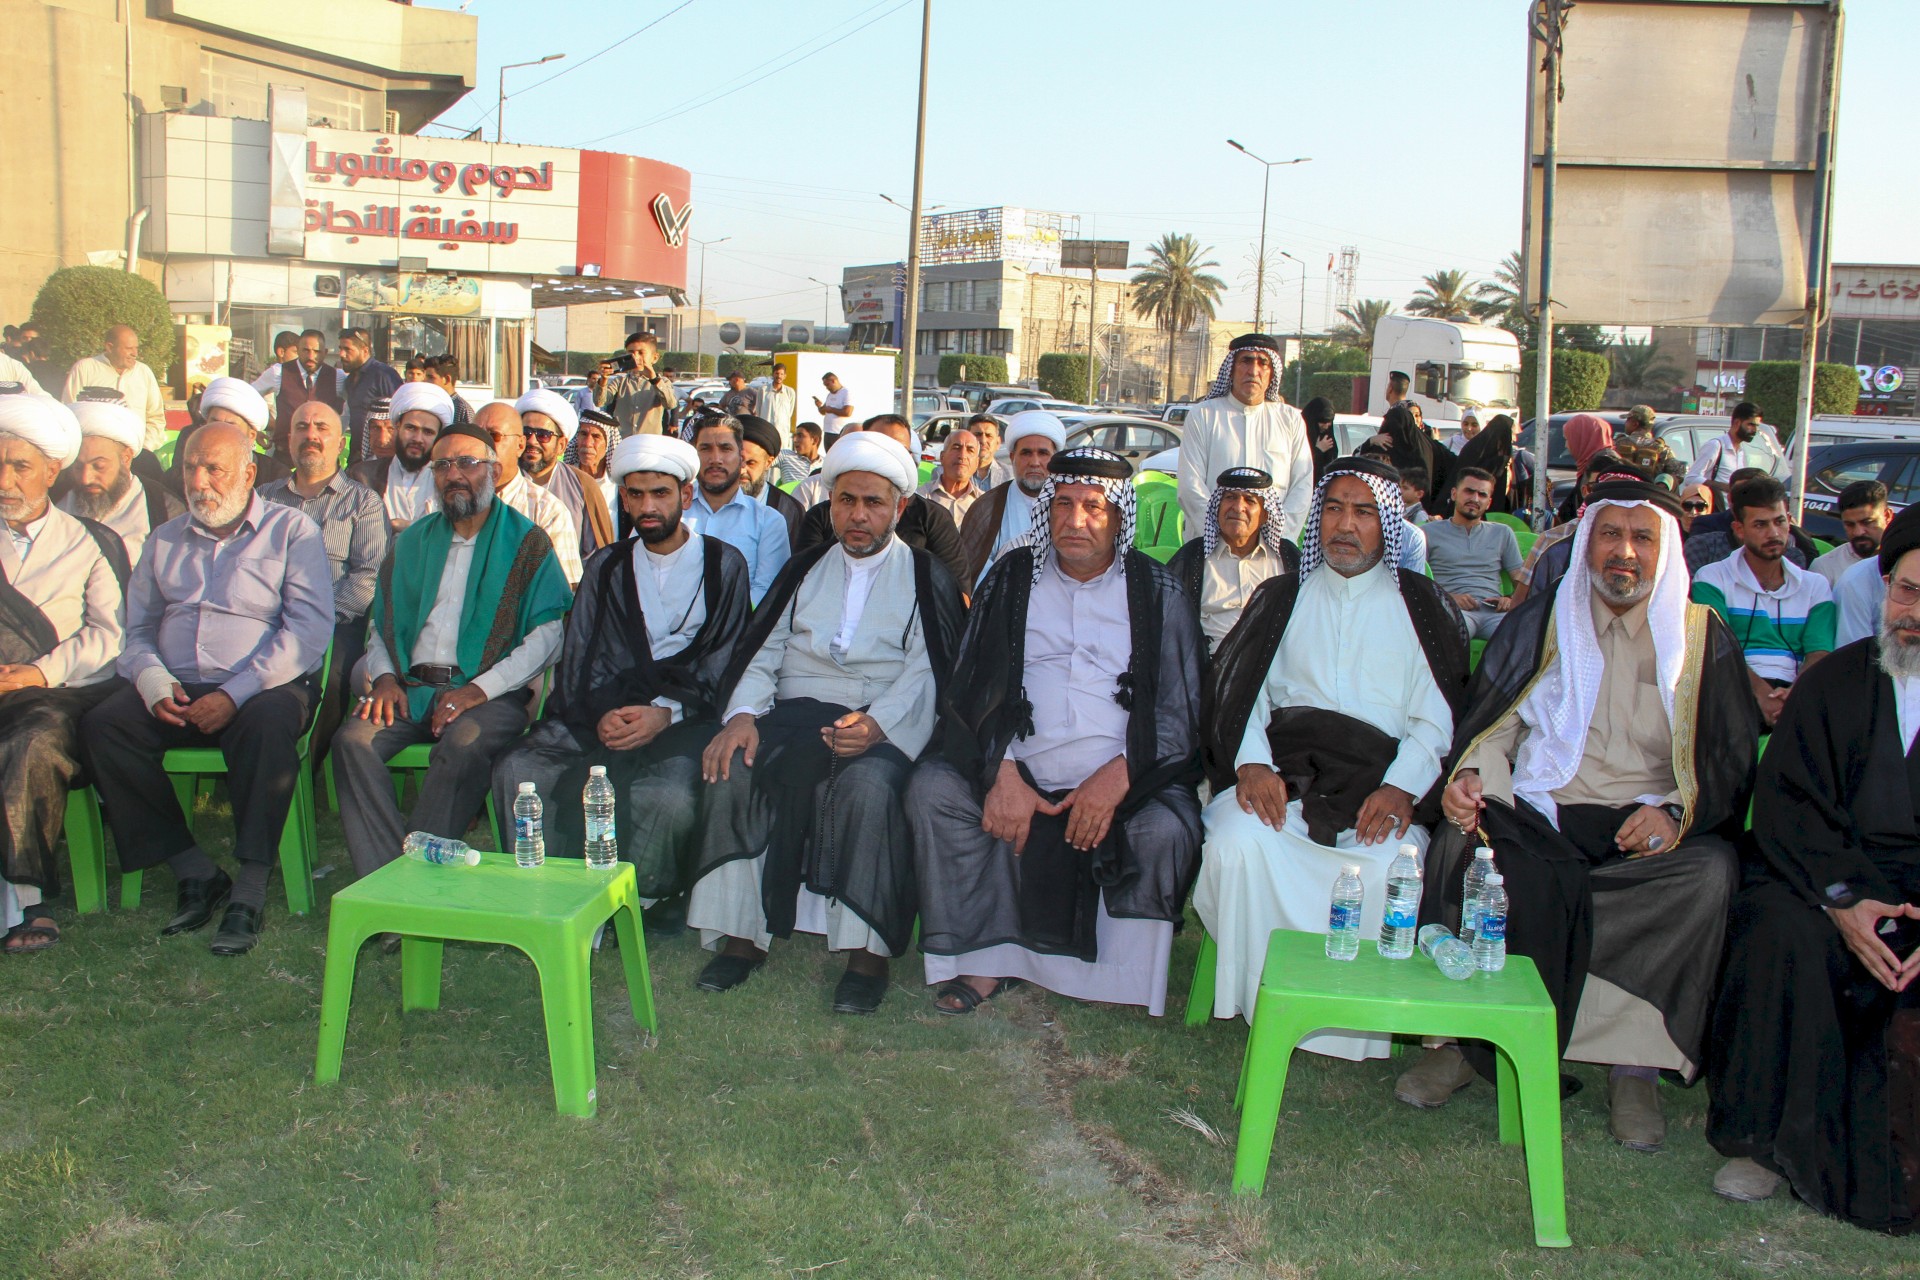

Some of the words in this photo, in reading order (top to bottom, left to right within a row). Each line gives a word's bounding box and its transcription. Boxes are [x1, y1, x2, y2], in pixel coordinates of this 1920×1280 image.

[306, 137, 457, 194] ومشويا
[462, 161, 554, 198] لحوم
[305, 198, 400, 244] النجاة
[406, 204, 519, 251] سفينة
